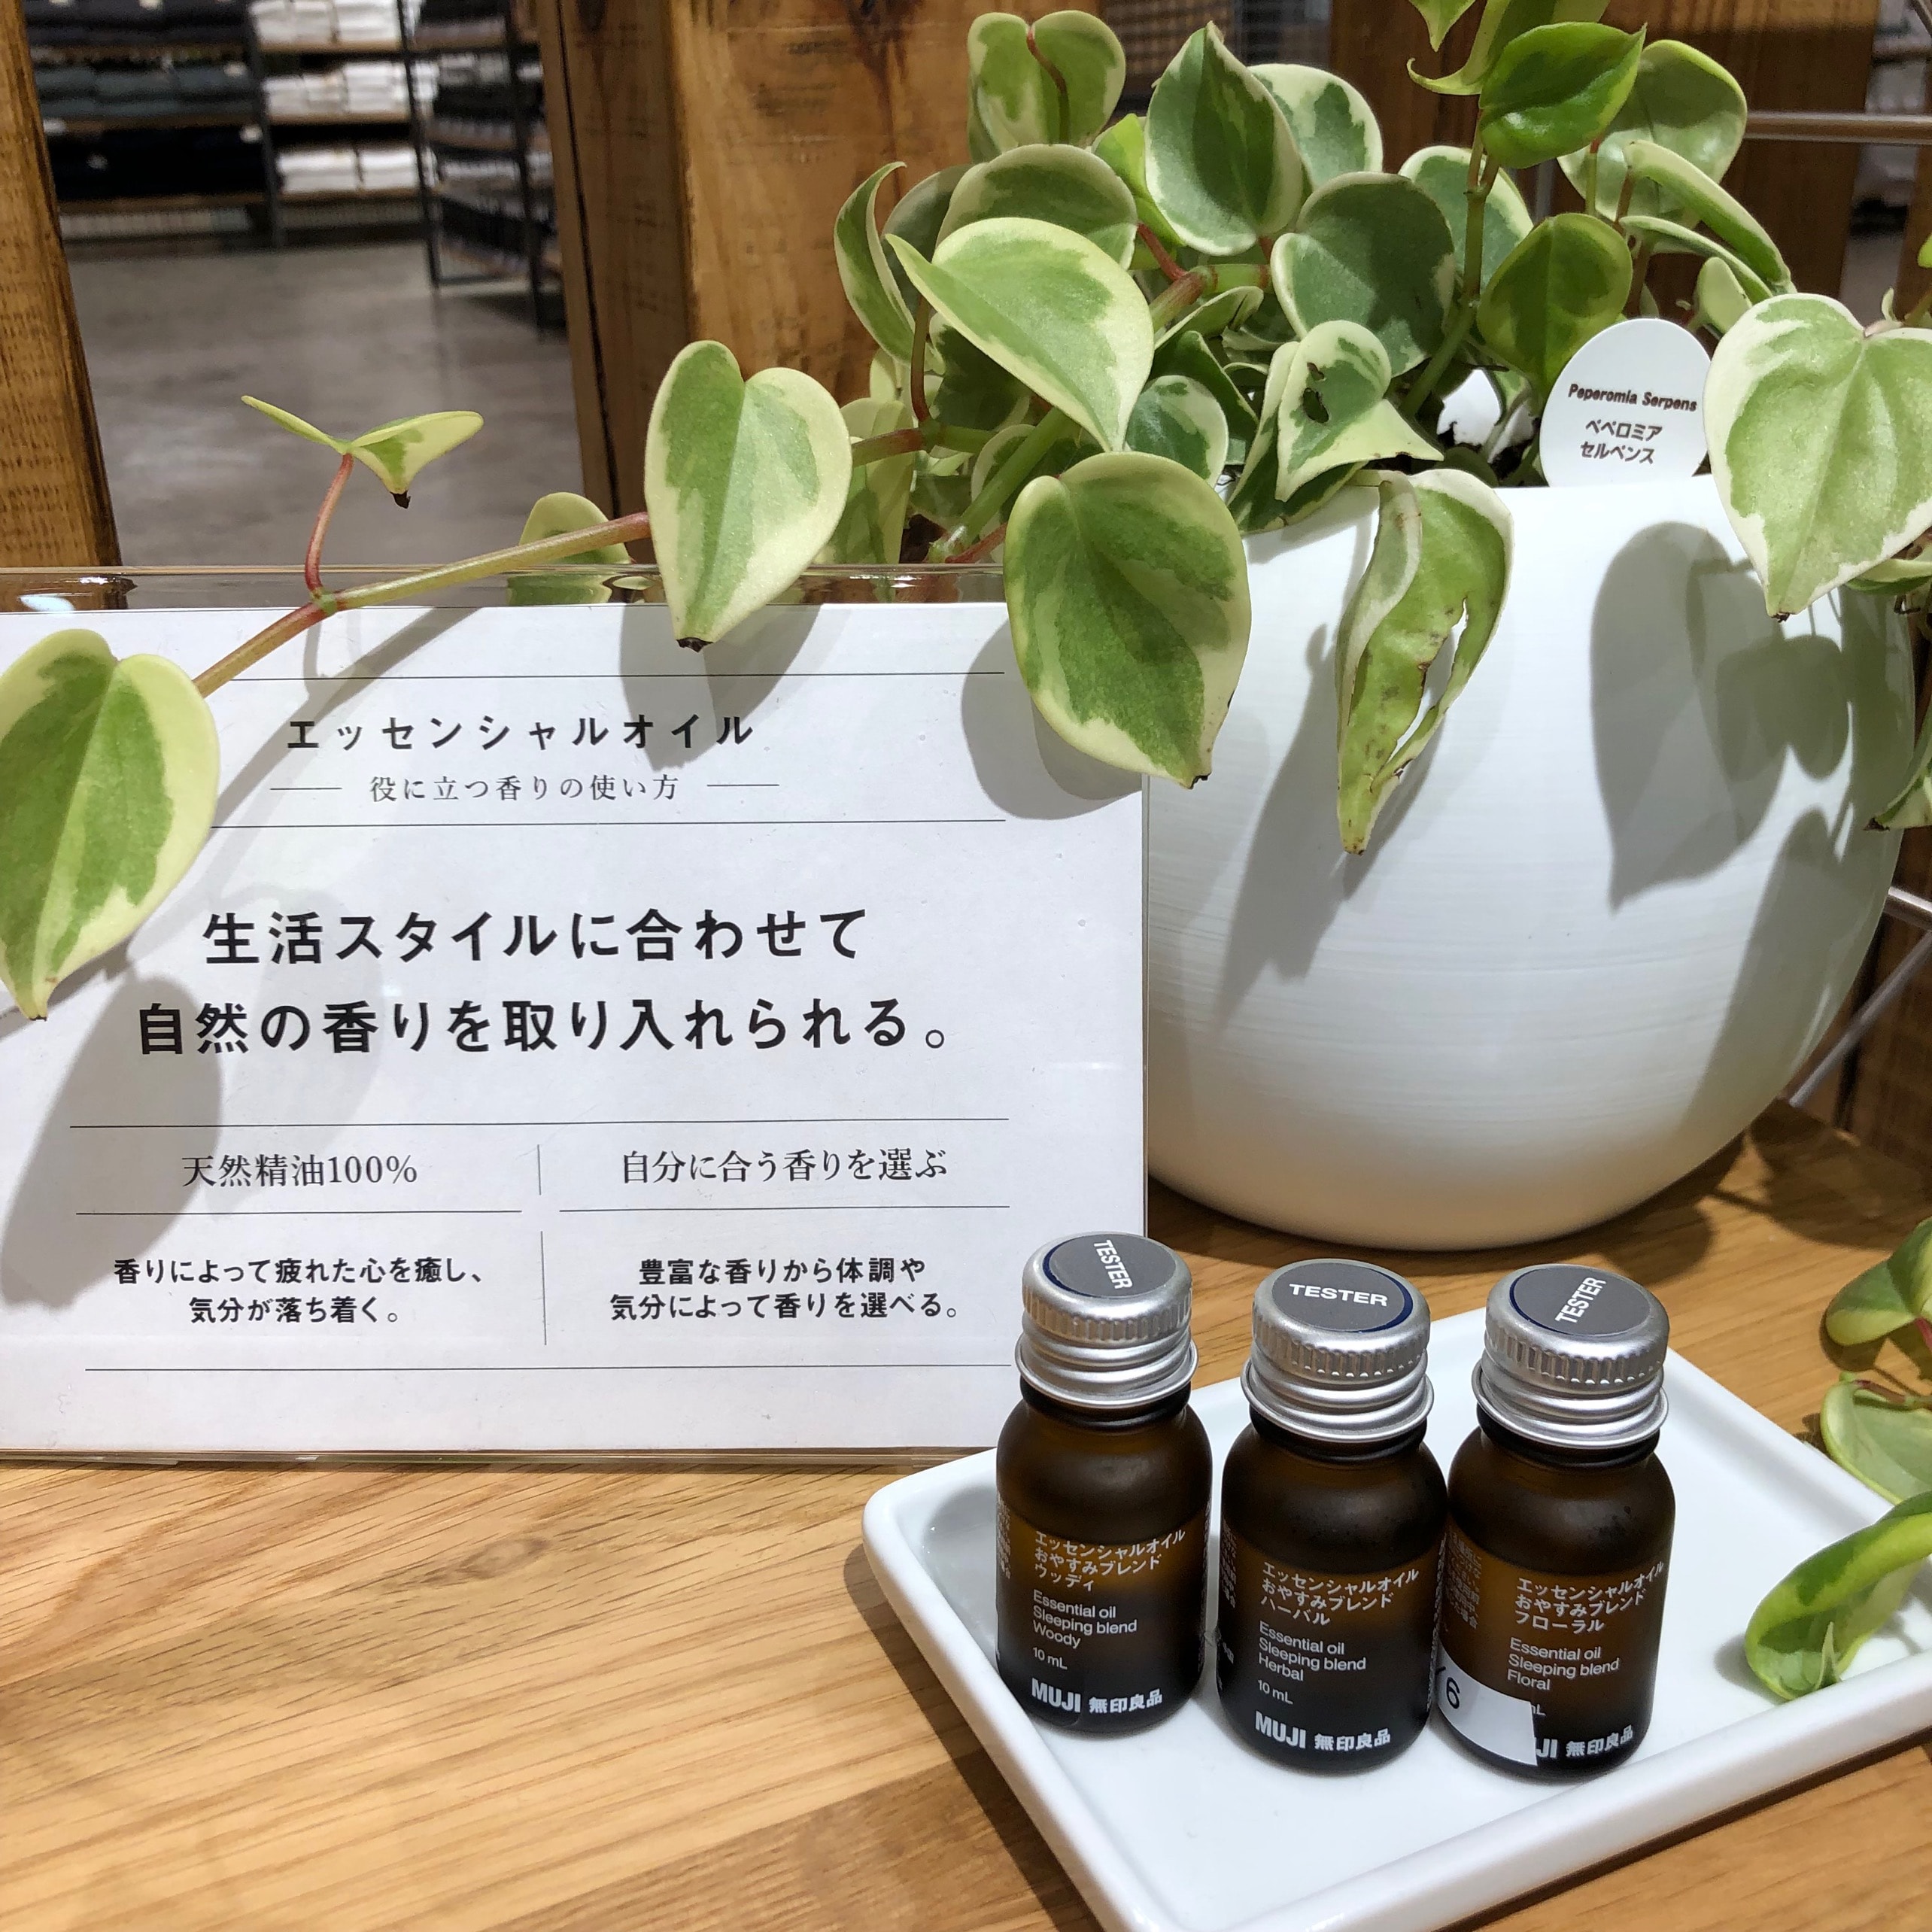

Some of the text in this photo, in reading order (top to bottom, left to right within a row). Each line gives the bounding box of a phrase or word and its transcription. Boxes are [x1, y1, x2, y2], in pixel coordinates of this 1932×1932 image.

[1569, 384, 1697, 412] Peperomia Serpens
[287, 715, 753, 750] エッセンシャルオイル
[371, 774, 678, 802] 役に立つ香りの使い方
[202, 908, 865, 964] 生活スタイルに合わせて
[140, 998, 944, 1054] 自然の香りを取り入れられる。
[182, 1154, 417, 1186] 天然精油100%
[624, 1148, 946, 1183] 自分に合う香りを選ぶ
[114, 1257, 481, 1284] 香りによって疲れた心を癒し、
[639, 1257, 925, 1284] 豊富な香りから体調や
[1094, 1240, 1132, 1289] TESTER
[189, 1296, 397, 1323] 気分が落ち着く。
[610, 1293, 955, 1320] 気分によって香りを選べる。
[1290, 1284, 1387, 1306] TESTER
[1555, 1277, 1605, 1323] TESTER
[1035, 1529, 1186, 1560] エッセンシャルオイル
[1035, 1548, 1162, 1575] おやすみブレンド
[1034, 1563, 1094, 1591] ウッディ
[1263, 1562, 1419, 1595] エッセンシャルオイル
[1517, 1561, 1663, 1601] エッセンシャルオイル
[1033, 1589, 1116, 1618] Essential oil
[1262, 1578, 1393, 1611] おやすみブレンド
[1514, 1588, 1646, 1617] おやすみブレンド
[1033, 1605, 1138, 1636] Sleeping blend
[1261, 1596, 1331, 1626] ハーバル
[1514, 1610, 1605, 1634] フローラル
[1033, 1621, 1081, 1649] Woody
[1259, 1621, 1323, 1653] Essential
[1327, 1642, 1344, 1654] oil
[1509, 1637, 1601, 1660] Essential oil
[1033, 1647, 1068, 1669] 10 mL
[1259, 1637, 1320, 1671] Sleeping
[1324, 1657, 1366, 1671] blend
[1259, 1652, 1303, 1681] Herbal
[1508, 1654, 1620, 1679] Sleeping blend
[1258, 1679, 1293, 1705] 10 mL
[1507, 1669, 1551, 1690] Floral
[1031, 1678, 1162, 1714] MUJI 無印良品
[1255, 1710, 1391, 1751] MUJI 無印良品
[1566, 1724, 1633, 1757] 無印良品
